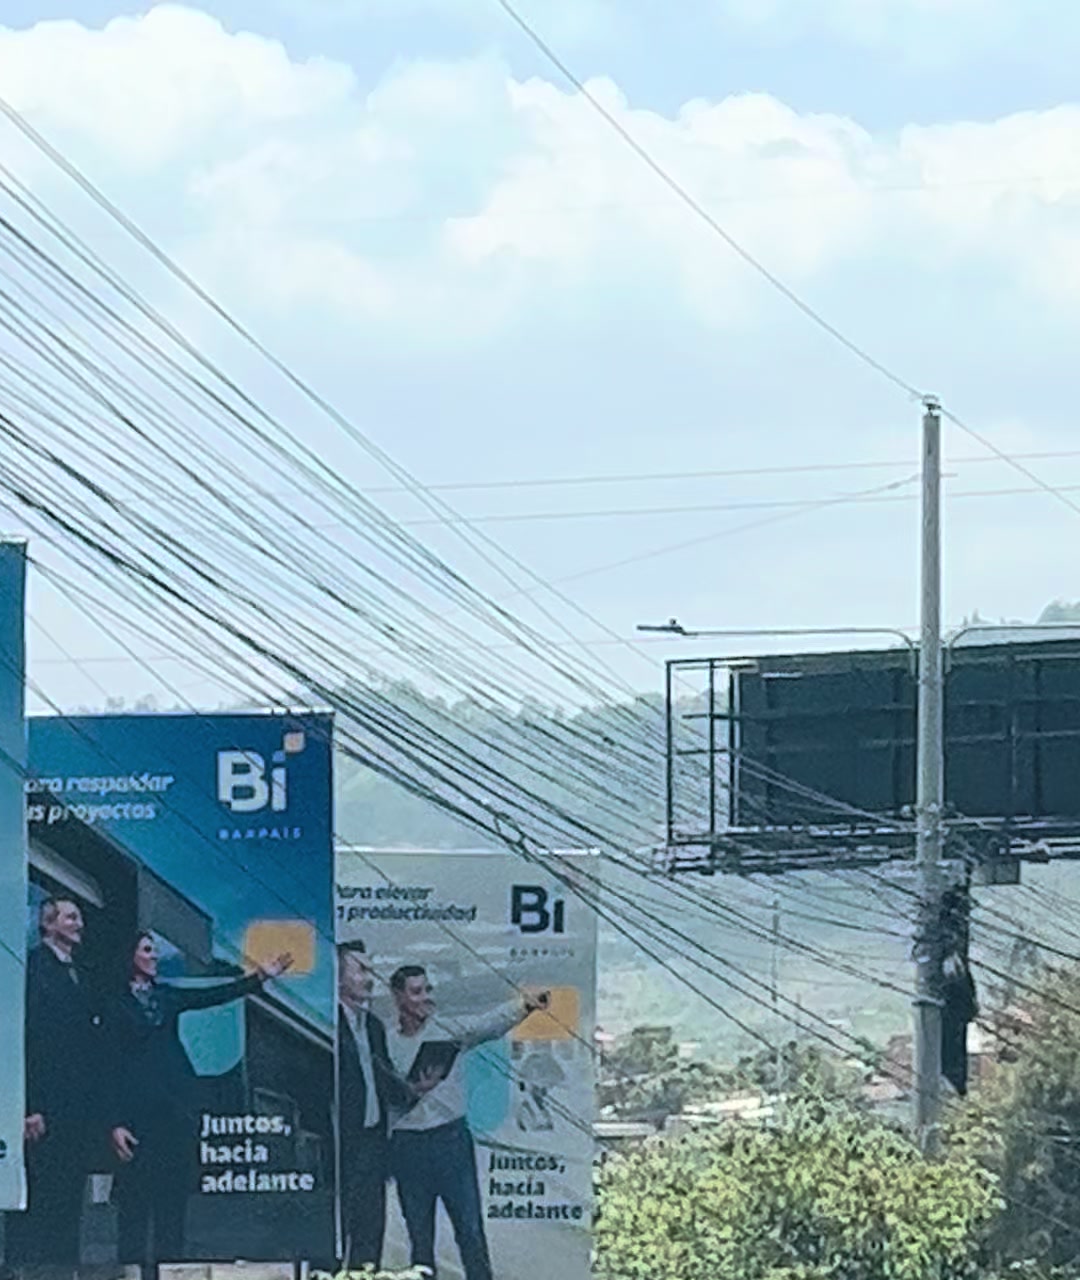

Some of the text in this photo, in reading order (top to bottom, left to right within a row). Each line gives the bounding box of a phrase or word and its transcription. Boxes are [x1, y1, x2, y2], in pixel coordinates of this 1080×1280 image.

[24, 776, 62, 793] ara
[217, 750, 287, 813] Bi
[47, 803, 155, 825] proyectos
[511, 884, 565, 933] Bi
[200, 1113, 292, 1138] Juntos,
[200, 1138, 269, 1165] hacia
[488, 1152, 565, 1173] Juntos,
[201, 1169, 315, 1193] adelante
[489, 1175, 545, 1196] hacia
[487, 1201, 583, 1219] adelante
